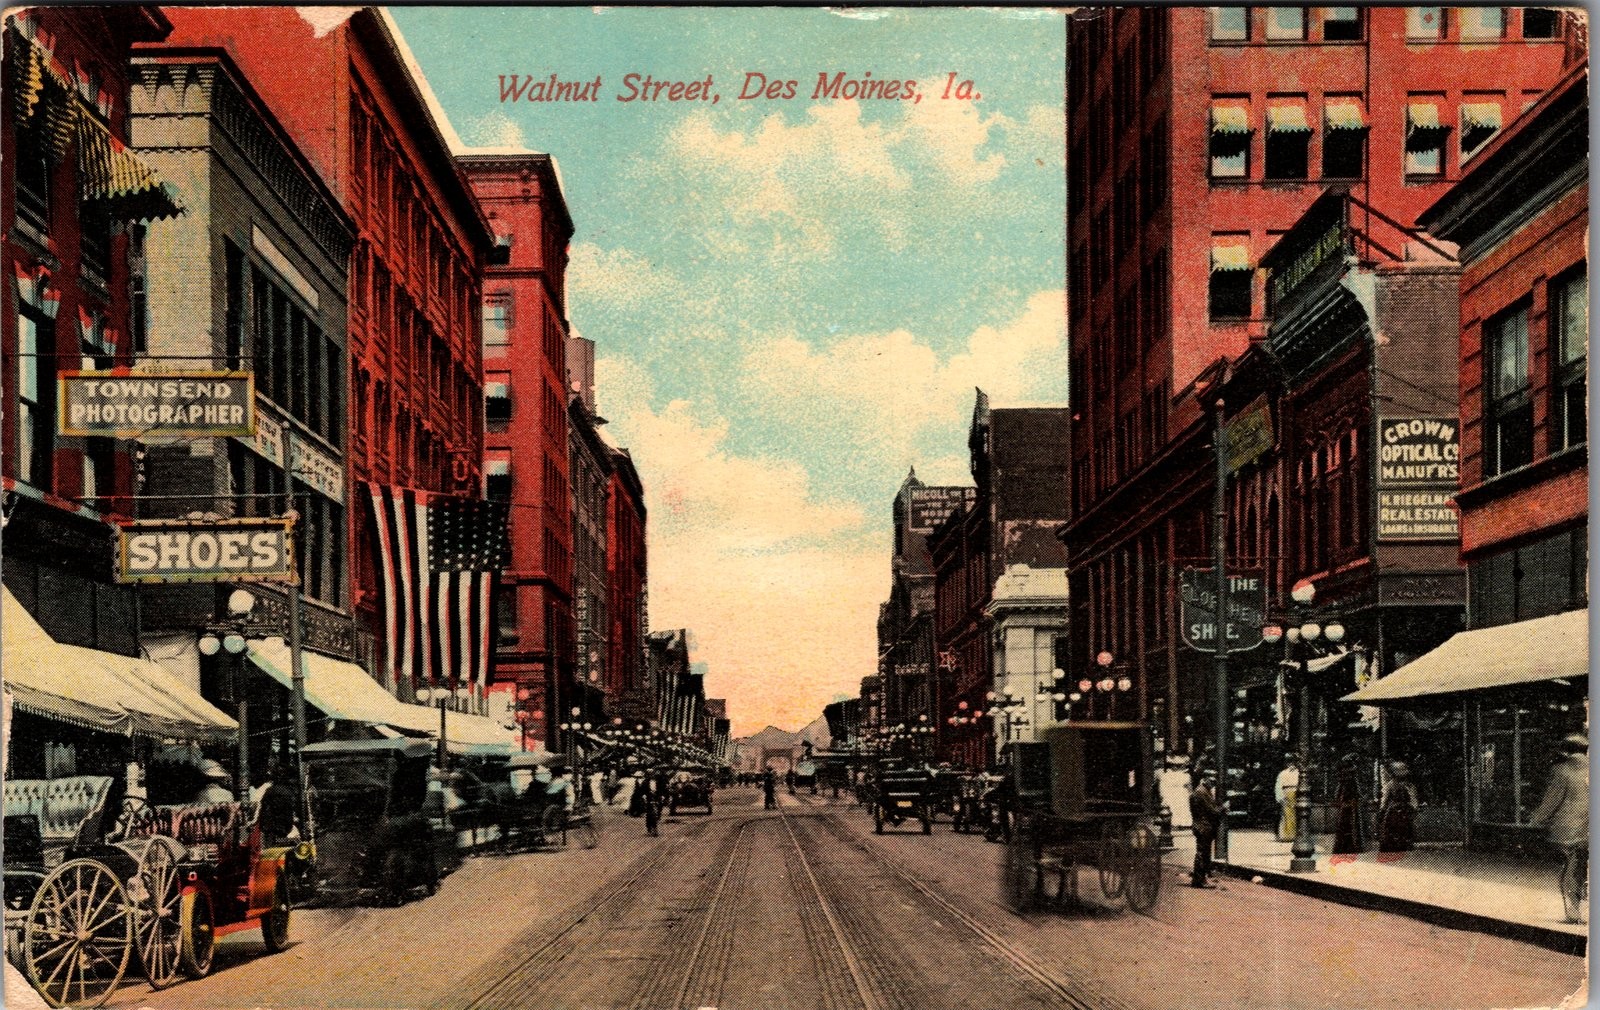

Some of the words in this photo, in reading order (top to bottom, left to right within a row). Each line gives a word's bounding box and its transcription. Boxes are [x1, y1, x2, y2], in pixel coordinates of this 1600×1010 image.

[84, 382, 232, 399] TOWNSEND
[70, 404, 244, 425] PHOTOGRAPHER
[1384, 420, 1455, 443] CROWN
[1381, 443, 1442, 461] OPTICAL
[1393, 494, 1452, 506] RIEGELMA
[1381, 508, 1414, 521] REAL
[1414, 508, 1458, 521] ESTATE
[129, 533, 278, 570] SHOES
[1230, 578, 1258, 593] THE
[1190, 622, 1240, 640] SHE.
